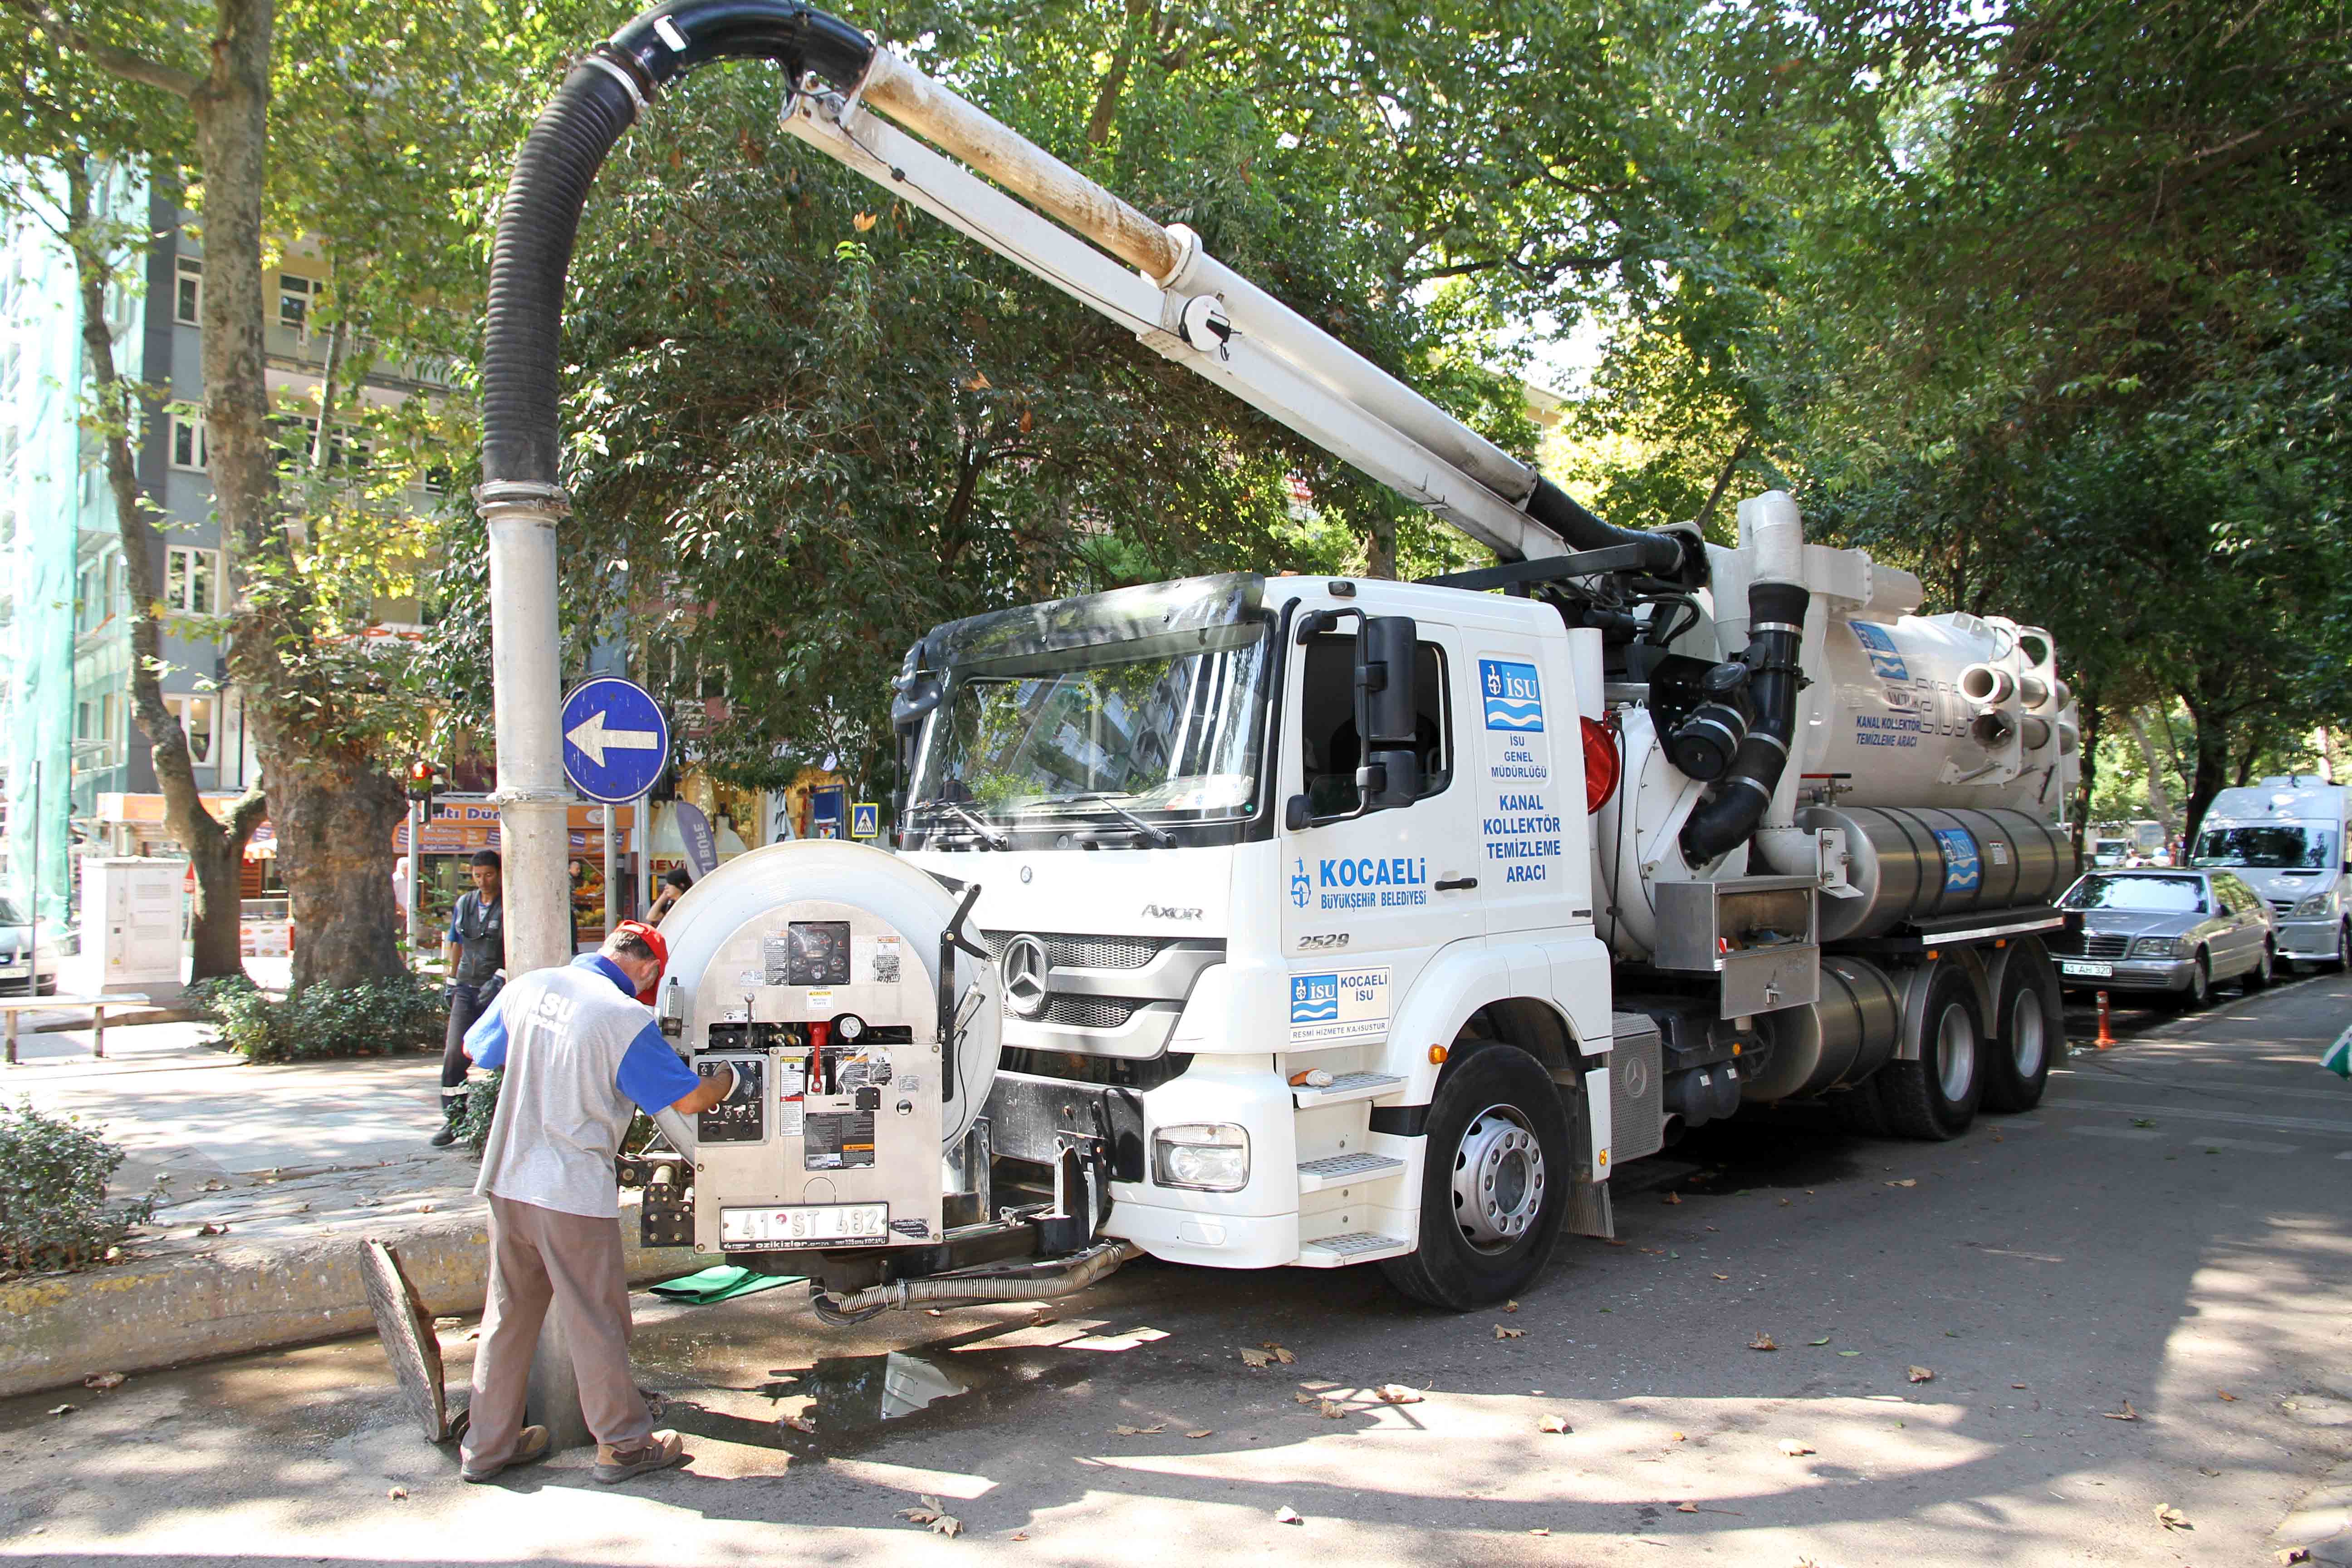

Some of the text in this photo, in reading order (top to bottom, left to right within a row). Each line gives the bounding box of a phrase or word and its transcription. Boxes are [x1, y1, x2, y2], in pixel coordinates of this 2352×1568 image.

[1506, 671, 1537, 699] İSU
[1857, 715, 1880, 729] KANAL
[1509, 733, 1525, 747] İSU
[1504, 751, 1533, 763] GENEL
[1491, 763, 1547, 778] MÜDÜRLÜĞÜ
[1499, 794, 1544, 811] KANAL
[1483, 813, 1561, 835] KOLLEKTÖR
[1486, 838, 1561, 859] TEMİZLEME
[1506, 864, 1546, 883] ARACI
[1297, 933, 1349, 951] 2529
[2065, 965, 2074, 973] 41
[2095, 966, 2112, 975] 320
[1340, 972, 1387, 988] KOCAELİ
[1310, 982, 1336, 999] İSU
[1355, 988, 1373, 1001] İSU
[1293, 1029, 1314, 1039] RESMİ
[1316, 1026, 1345, 1036] HİZMETE
[743, 1213, 768, 1239] 41
[792, 1210, 819, 1237] ST
[836, 1209, 878, 1235] 482
